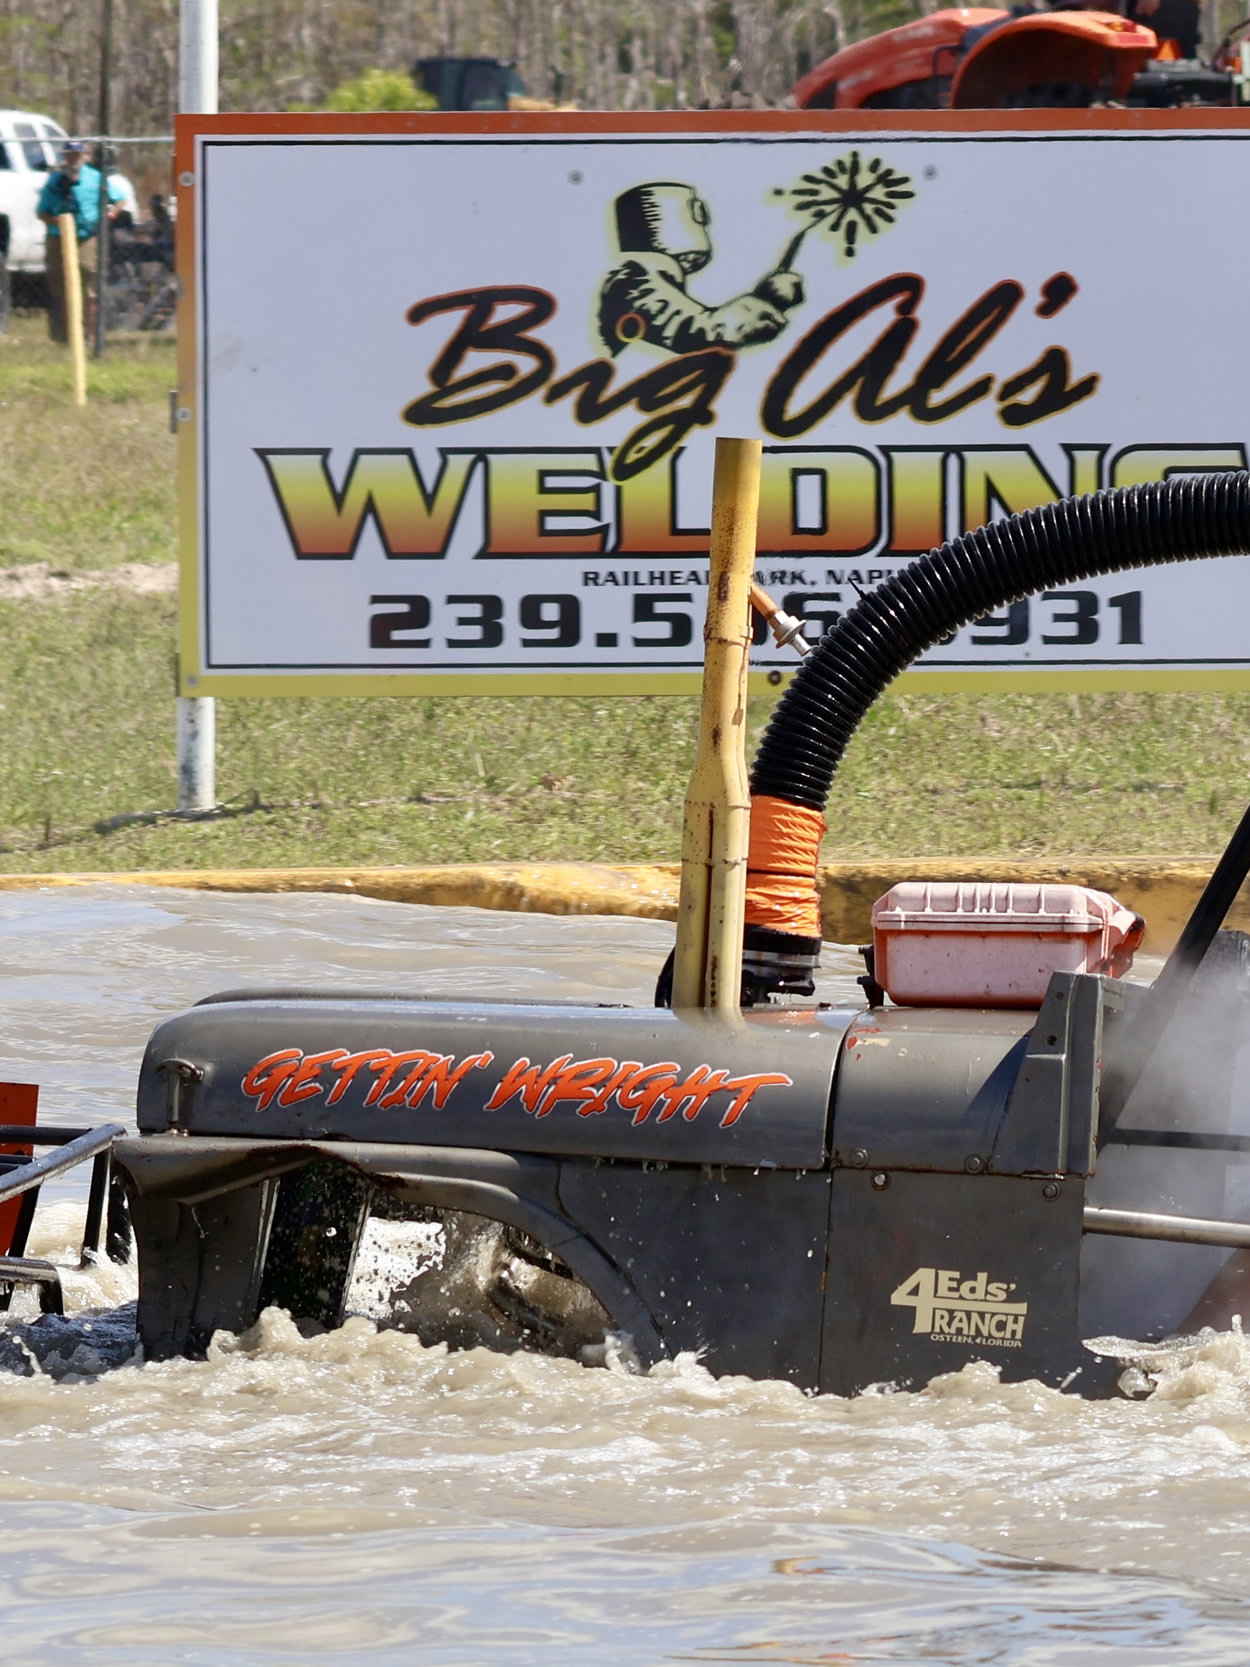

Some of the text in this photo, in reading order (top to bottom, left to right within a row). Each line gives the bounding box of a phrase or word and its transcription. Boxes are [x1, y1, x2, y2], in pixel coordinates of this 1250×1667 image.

[402, 271, 1100, 482] Big Al's
[583, 570, 710, 586] RAILHEA
[240, 1049, 794, 1128] GETTIN' WRIGHT
[933, 1309, 1026, 1340] RANCH
